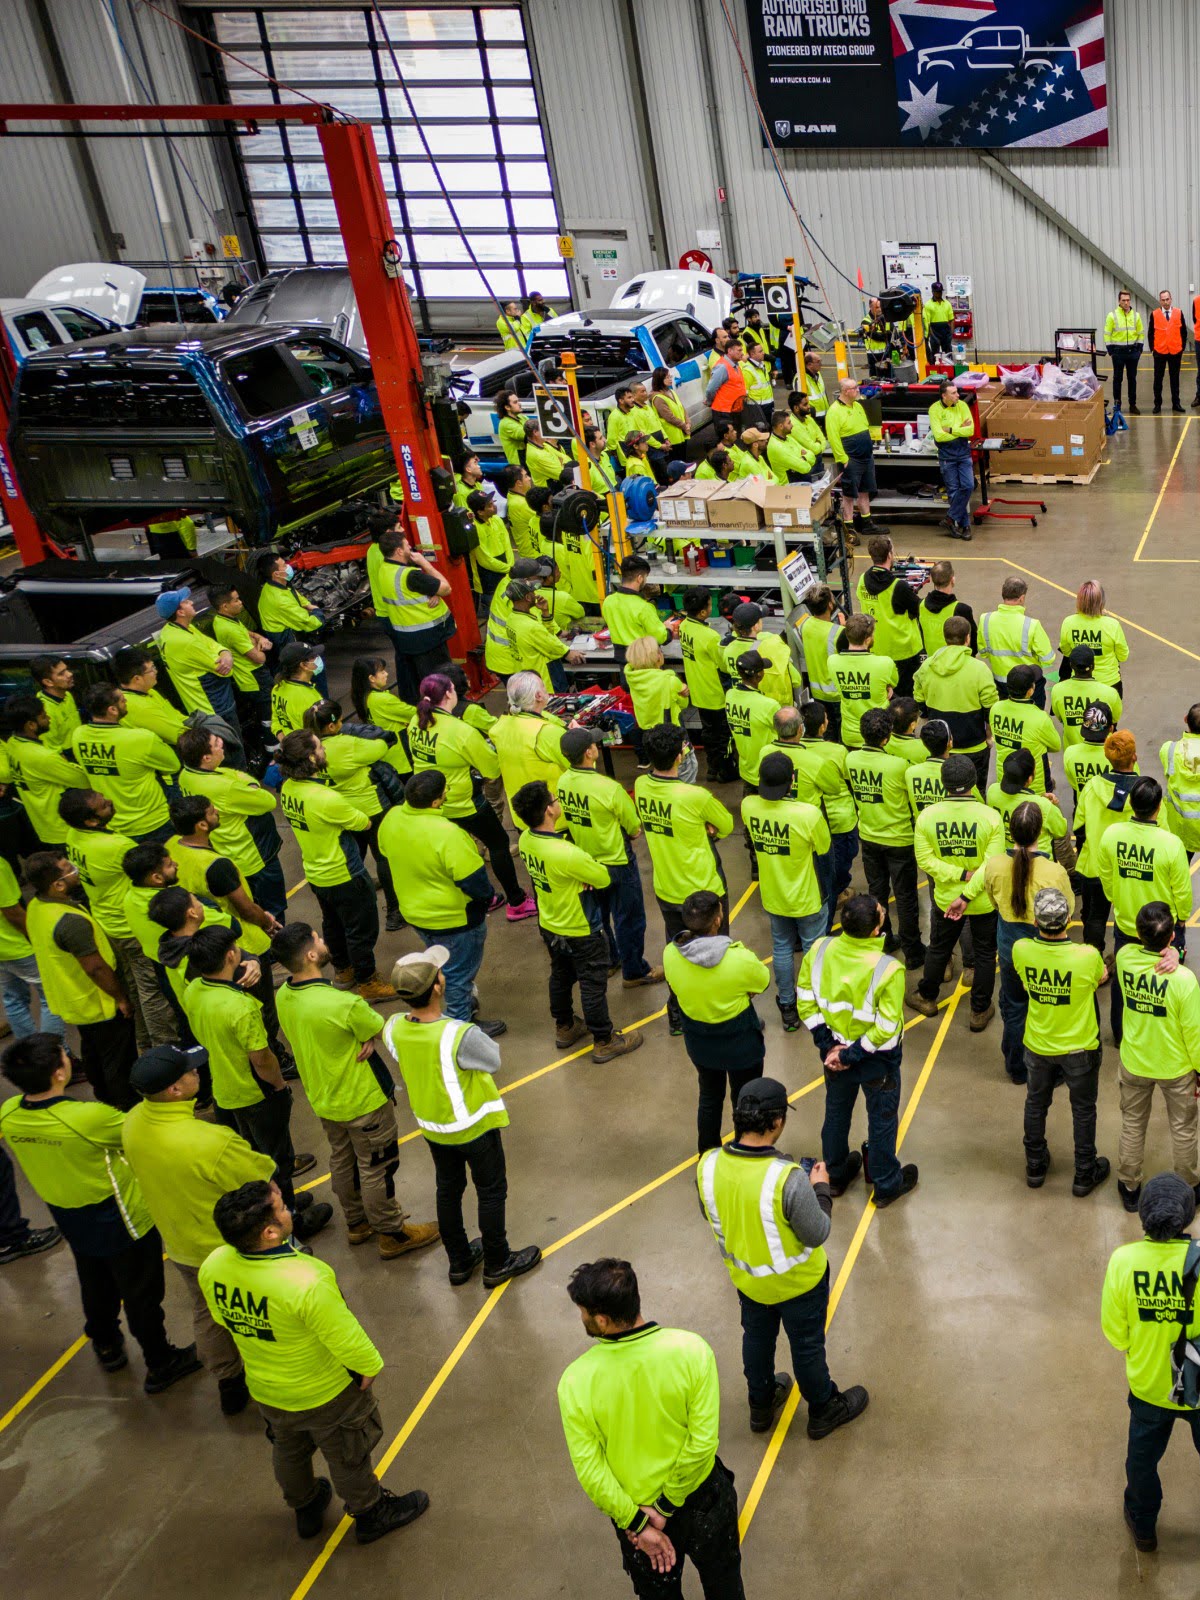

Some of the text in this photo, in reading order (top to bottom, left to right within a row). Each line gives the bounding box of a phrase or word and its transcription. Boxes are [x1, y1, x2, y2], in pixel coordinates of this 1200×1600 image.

[762, 0, 867, 15] AUTHORISED RHD
[764, 15, 871, 37] RAM TRUCKS
[766, 45, 875, 56] PIONEERED BY ATECO GROUP
[794, 124, 837, 133] RAM
[767, 285, 789, 309] Q
[544, 399, 568, 433] 3
[401, 445, 418, 492] MOLNAR
[1071, 629, 1102, 643] RAM
[836, 671, 871, 686] RAM
[839, 684, 871, 692] DOMINATION
[726, 702, 751, 722] RAM
[993, 714, 1024, 734] RAM
[994, 728, 1023, 741] DOMINATION
[79, 742, 116, 761] RAM
[849, 768, 883, 787] RAM
[1074, 762, 1109, 778] RAM
[912, 777, 948, 796] RAM
[281, 792, 305, 816] RAM
[558, 788, 589, 811] RAM
[914, 794, 945, 802] DOMINATIO
[638, 796, 673, 820] RAM
[750, 816, 790, 839] RAM
[935, 821, 978, 840] RAM
[754, 834, 790, 846] DOMINATION
[937, 838, 977, 847] DOMINATION
[1116, 841, 1156, 863] RAM
[520, 850, 547, 876] RAM
[1117, 859, 1155, 871] DOMINATION
[1126, 869, 1143, 879] CREW
[1025, 966, 1072, 987] RAM
[1122, 970, 1169, 999] RAM
[1026, 984, 1072, 995] DOMINATION
[1124, 989, 1165, 1005] DOMINATION
[1039, 994, 1059, 1005] CREW
[1136, 1002, 1154, 1014] CREW
[213, 1280, 269, 1320] RAM
[1155, 1308, 1177, 1321] CREW
[233, 1324, 258, 1337] CREW
